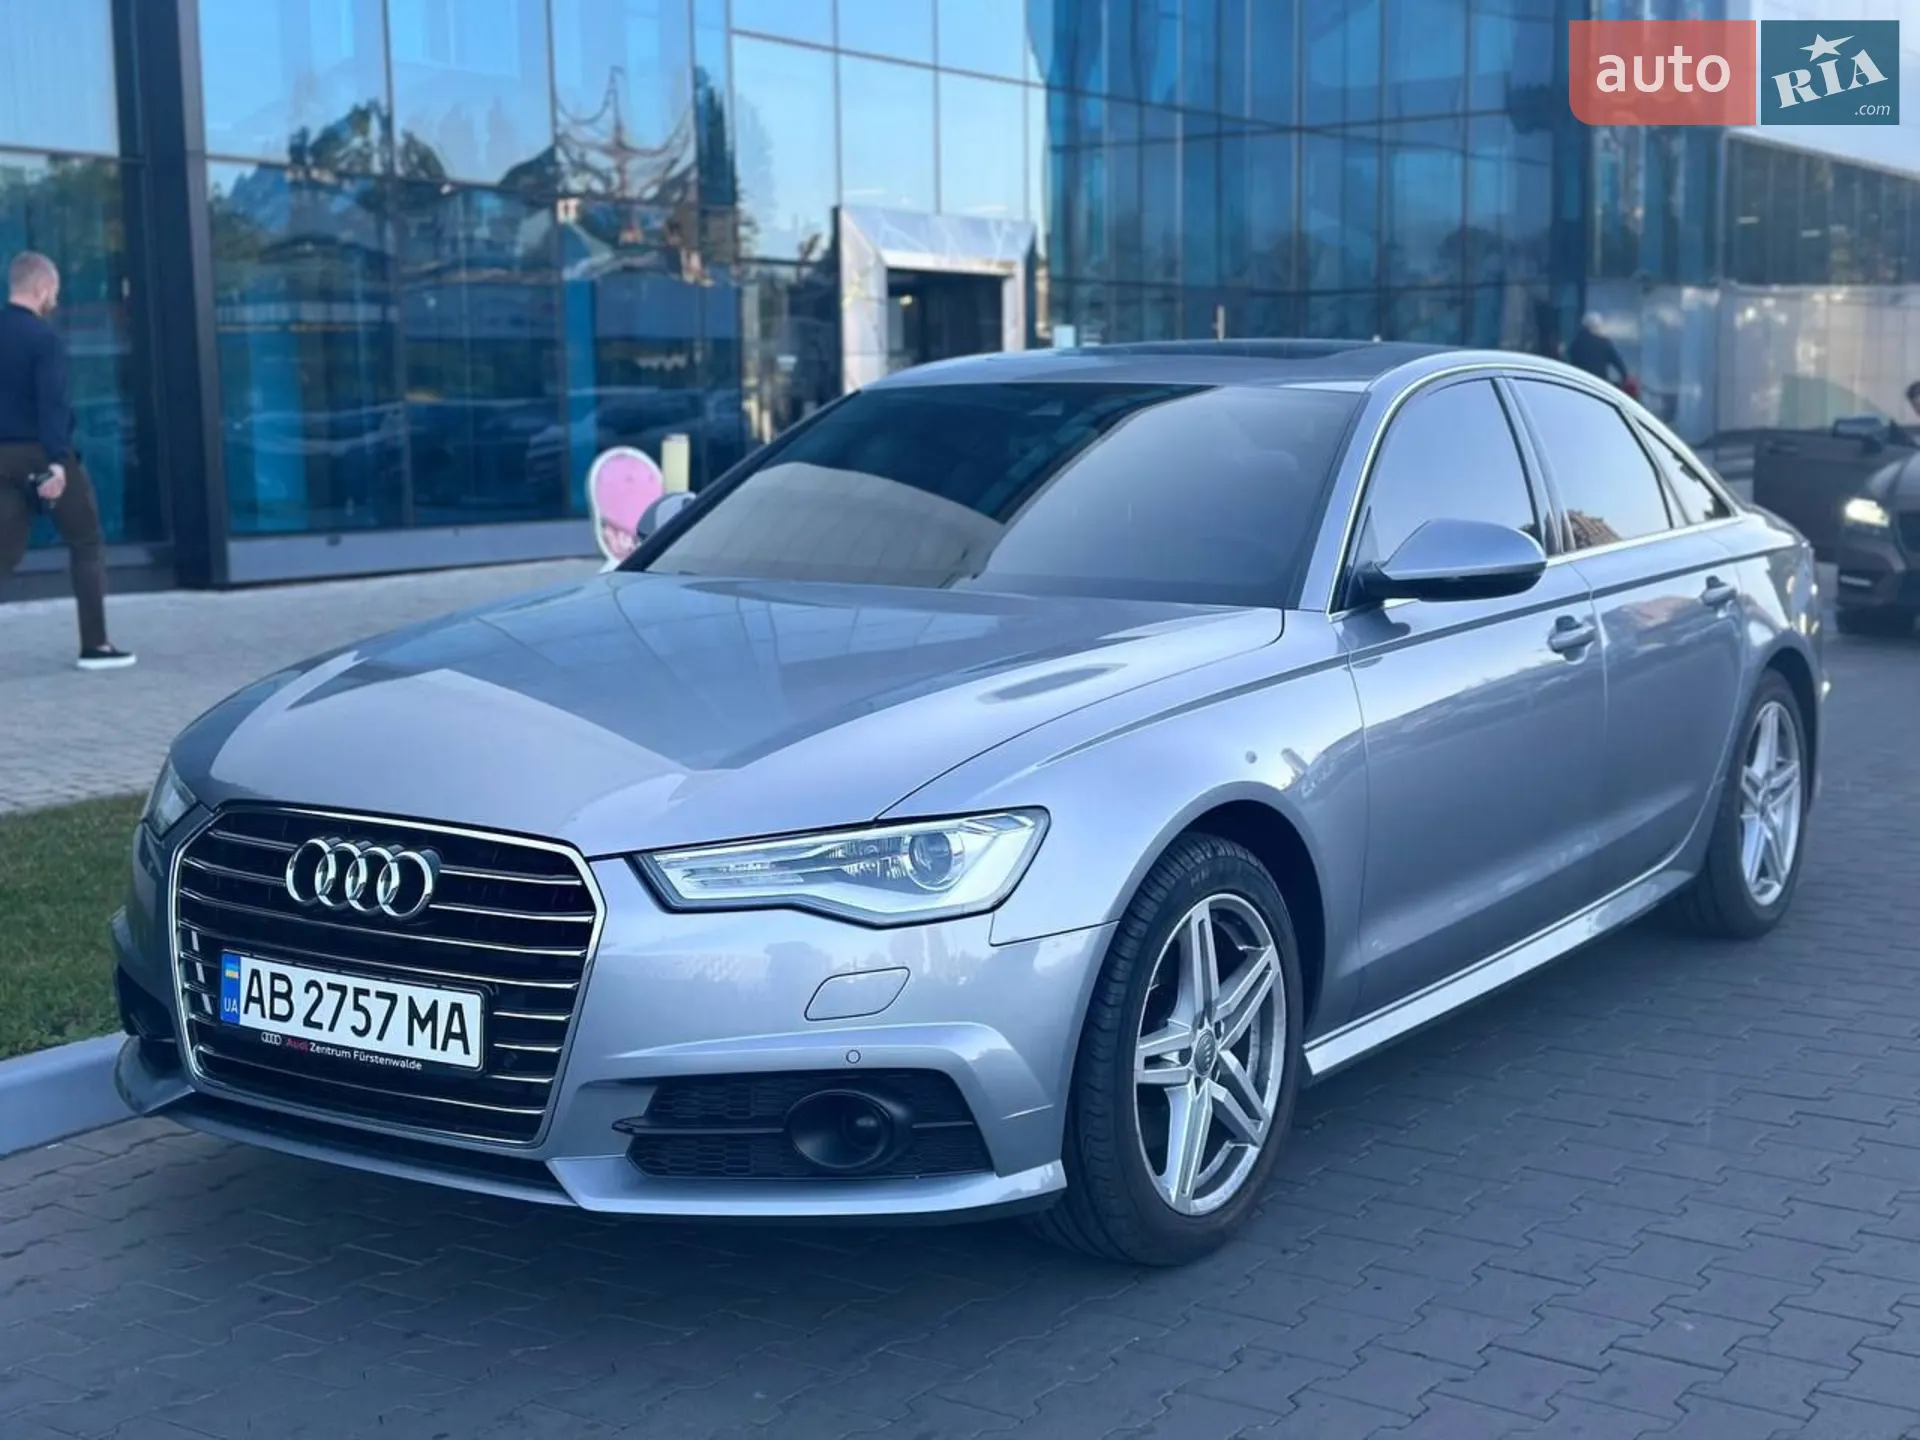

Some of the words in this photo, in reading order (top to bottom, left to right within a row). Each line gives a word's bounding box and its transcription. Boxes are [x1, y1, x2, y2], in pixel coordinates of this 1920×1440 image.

[224, 998, 239, 1014] UA
[243, 968, 294, 1023] AB
[303, 979, 398, 1041] 2757
[407, 995, 471, 1056] MA
[309, 1042, 351, 1060] Zentrum
[353, 1050, 423, 1070] Fürstenwalde
